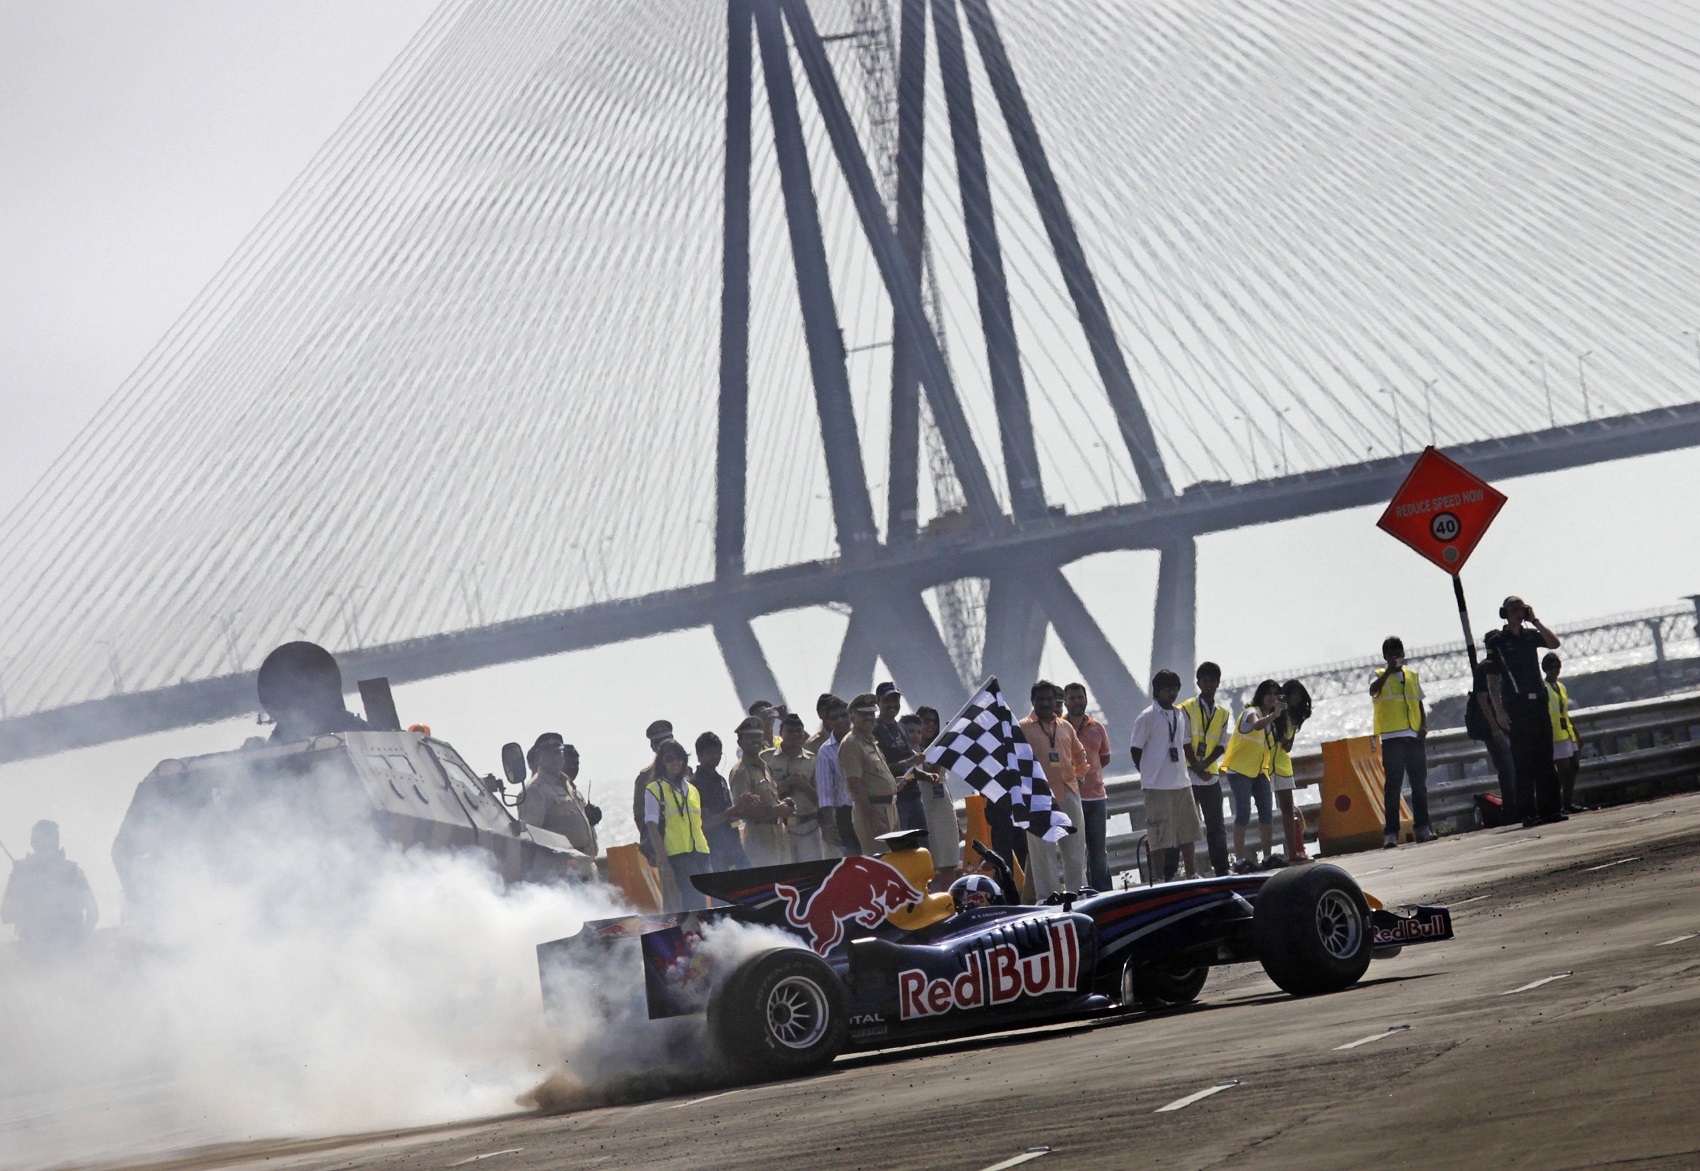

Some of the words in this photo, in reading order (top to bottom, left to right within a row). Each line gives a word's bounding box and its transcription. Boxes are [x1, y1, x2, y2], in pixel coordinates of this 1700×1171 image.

[1395, 499, 1432, 518] REDUCE
[1431, 493, 1461, 511] SPEED
[1462, 488, 1484, 503] NOW
[1435, 519, 1456, 535] 40
[1373, 919, 1406, 944] Red
[1405, 914, 1445, 939] Bull
[898, 950, 984, 1021] Red
[985, 919, 1079, 1005] Bull
